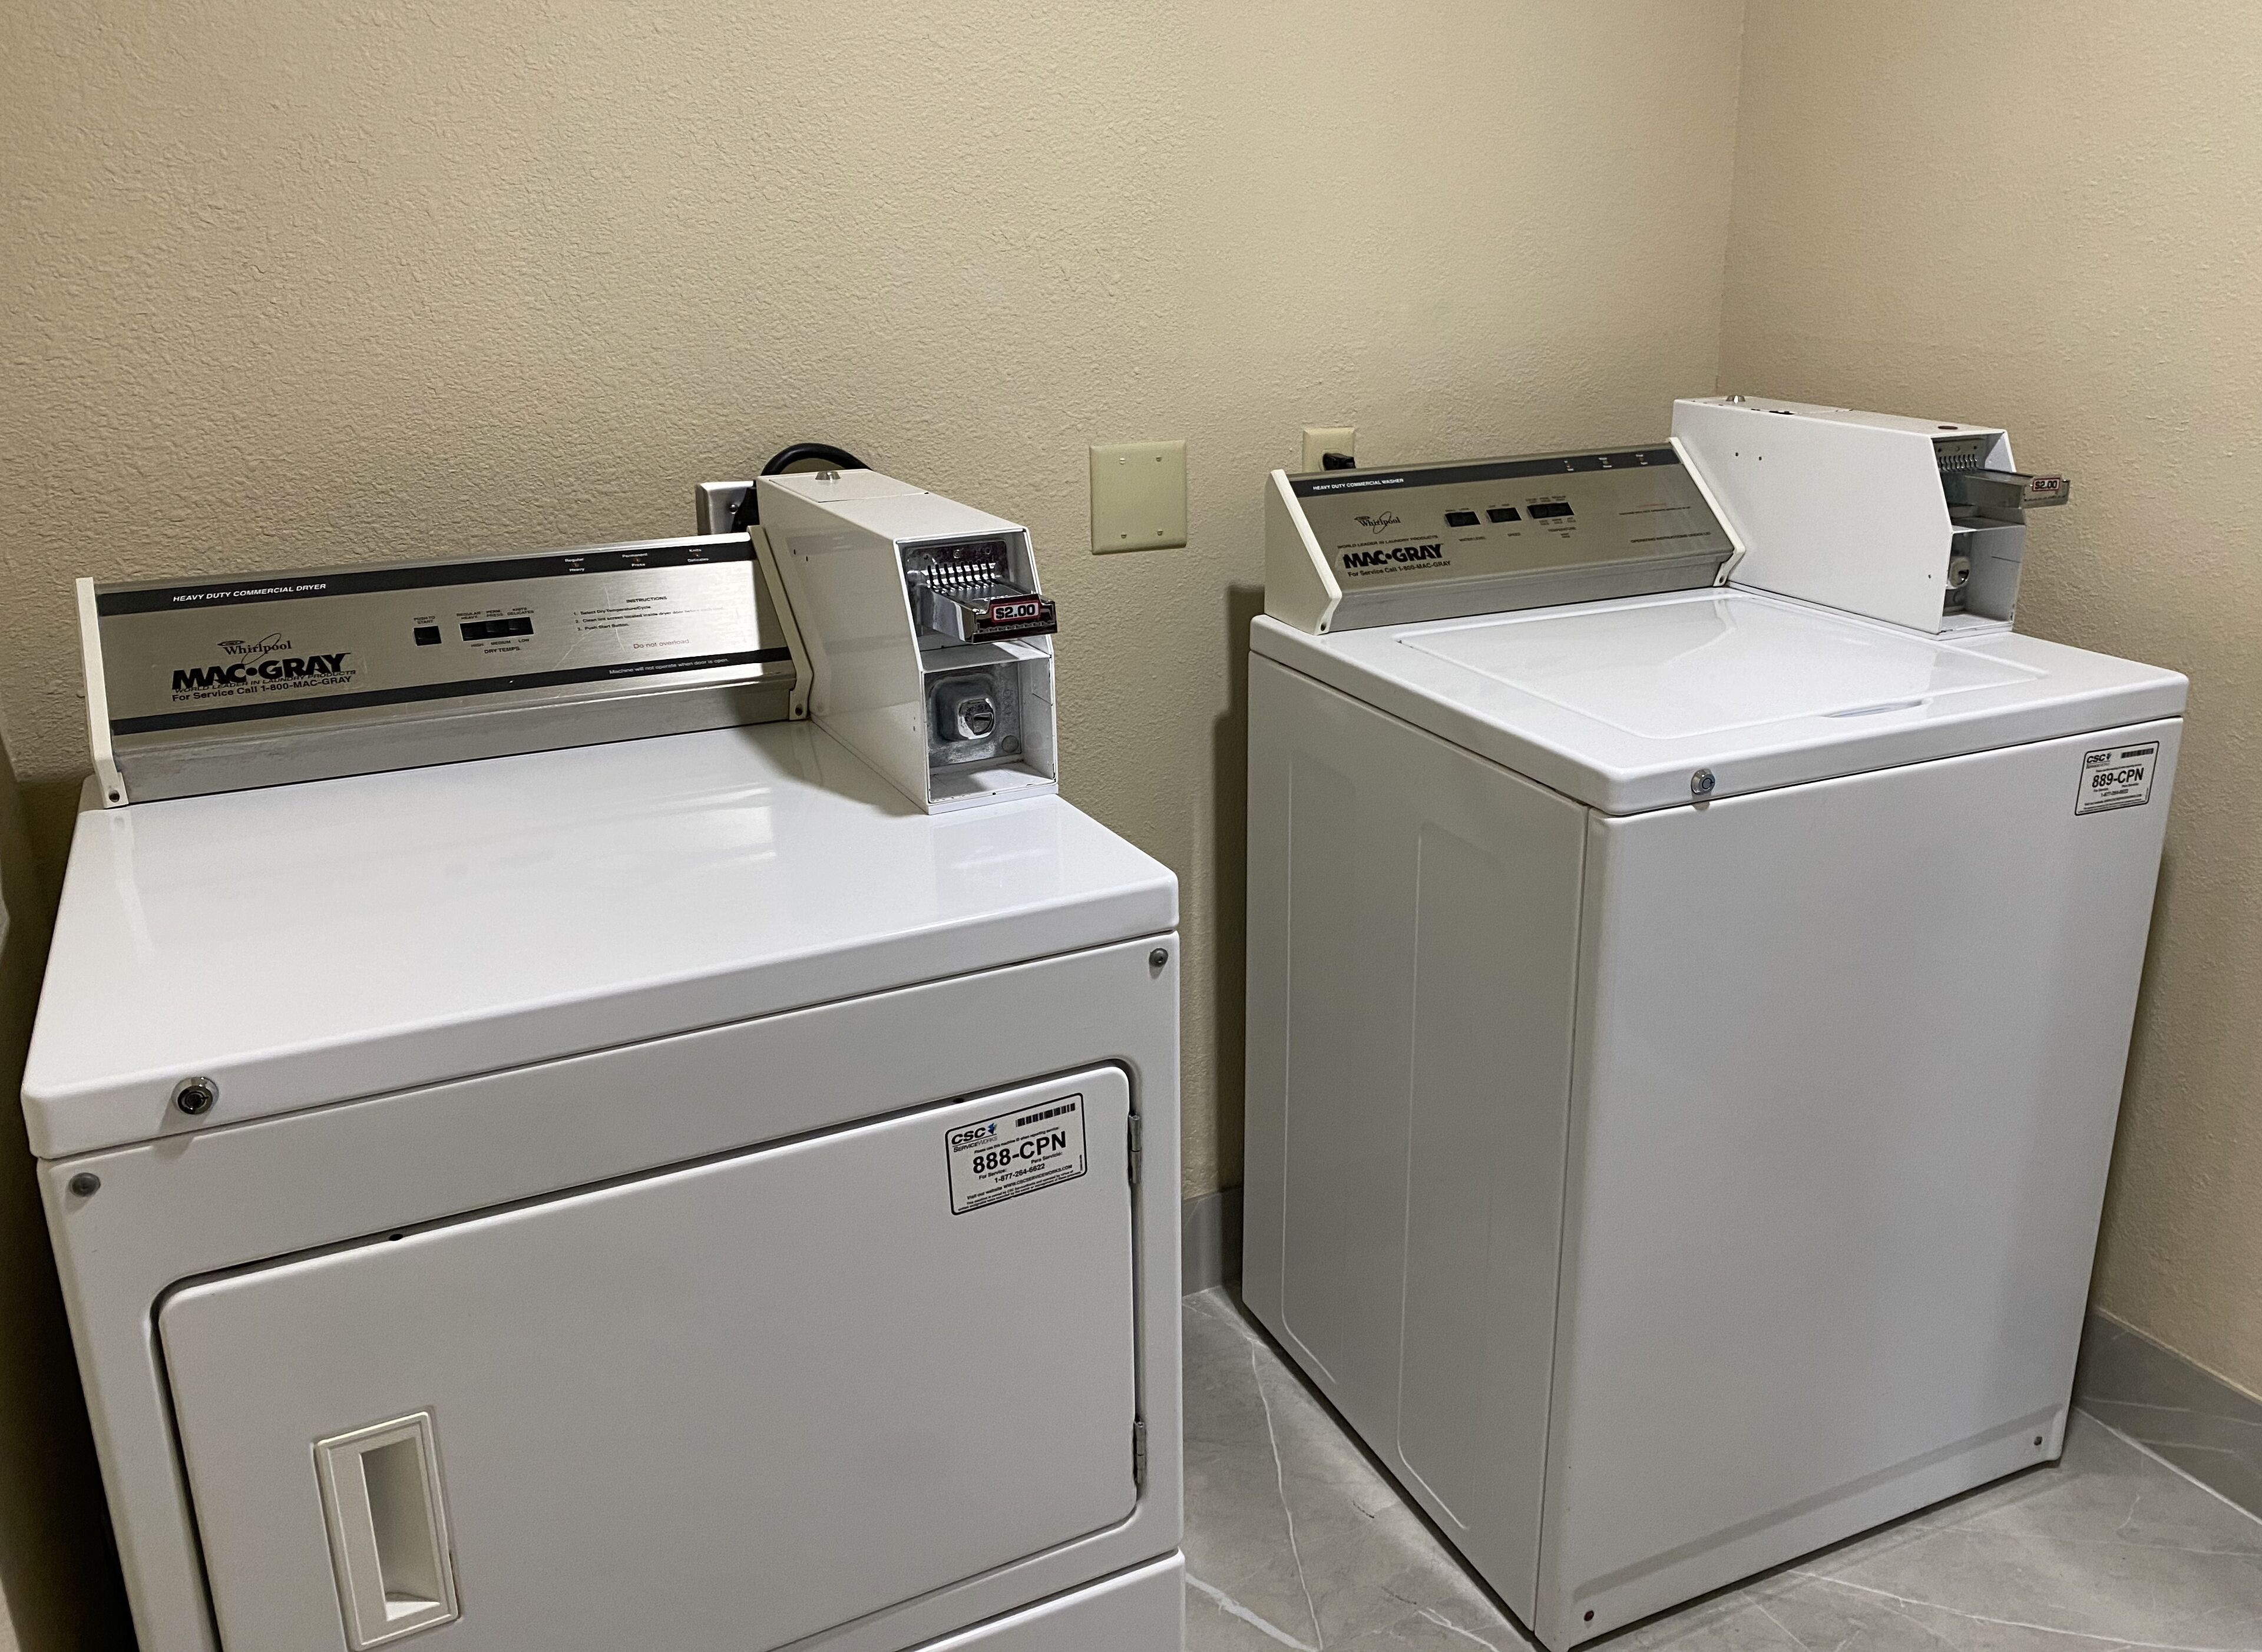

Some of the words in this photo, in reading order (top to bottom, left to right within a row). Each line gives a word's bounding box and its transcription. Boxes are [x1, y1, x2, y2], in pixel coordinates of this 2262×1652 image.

[2035, 481, 2057, 489] $2.00
[1360, 517, 1401, 527] Whirlpool
[1399, 561, 1451, 571] 1-800-MAC-GRAY
[173, 594, 204, 602] HEAVY
[233, 587, 294, 597] COMMERCIAL
[996, 604, 1035, 619] $2.00
[223, 640, 292, 655] Whirlpool
[193, 690, 234, 699] Service
[237, 686, 257, 694] Call
[261, 676, 352, 691] 1-800-MAC-GRAY
[2086, 754, 2106, 763] CSC
[2092, 767, 2144, 787] 889-CPN
[951, 1127, 986, 1144] CSC
[973, 1131, 1066, 1173] 888-CPN
